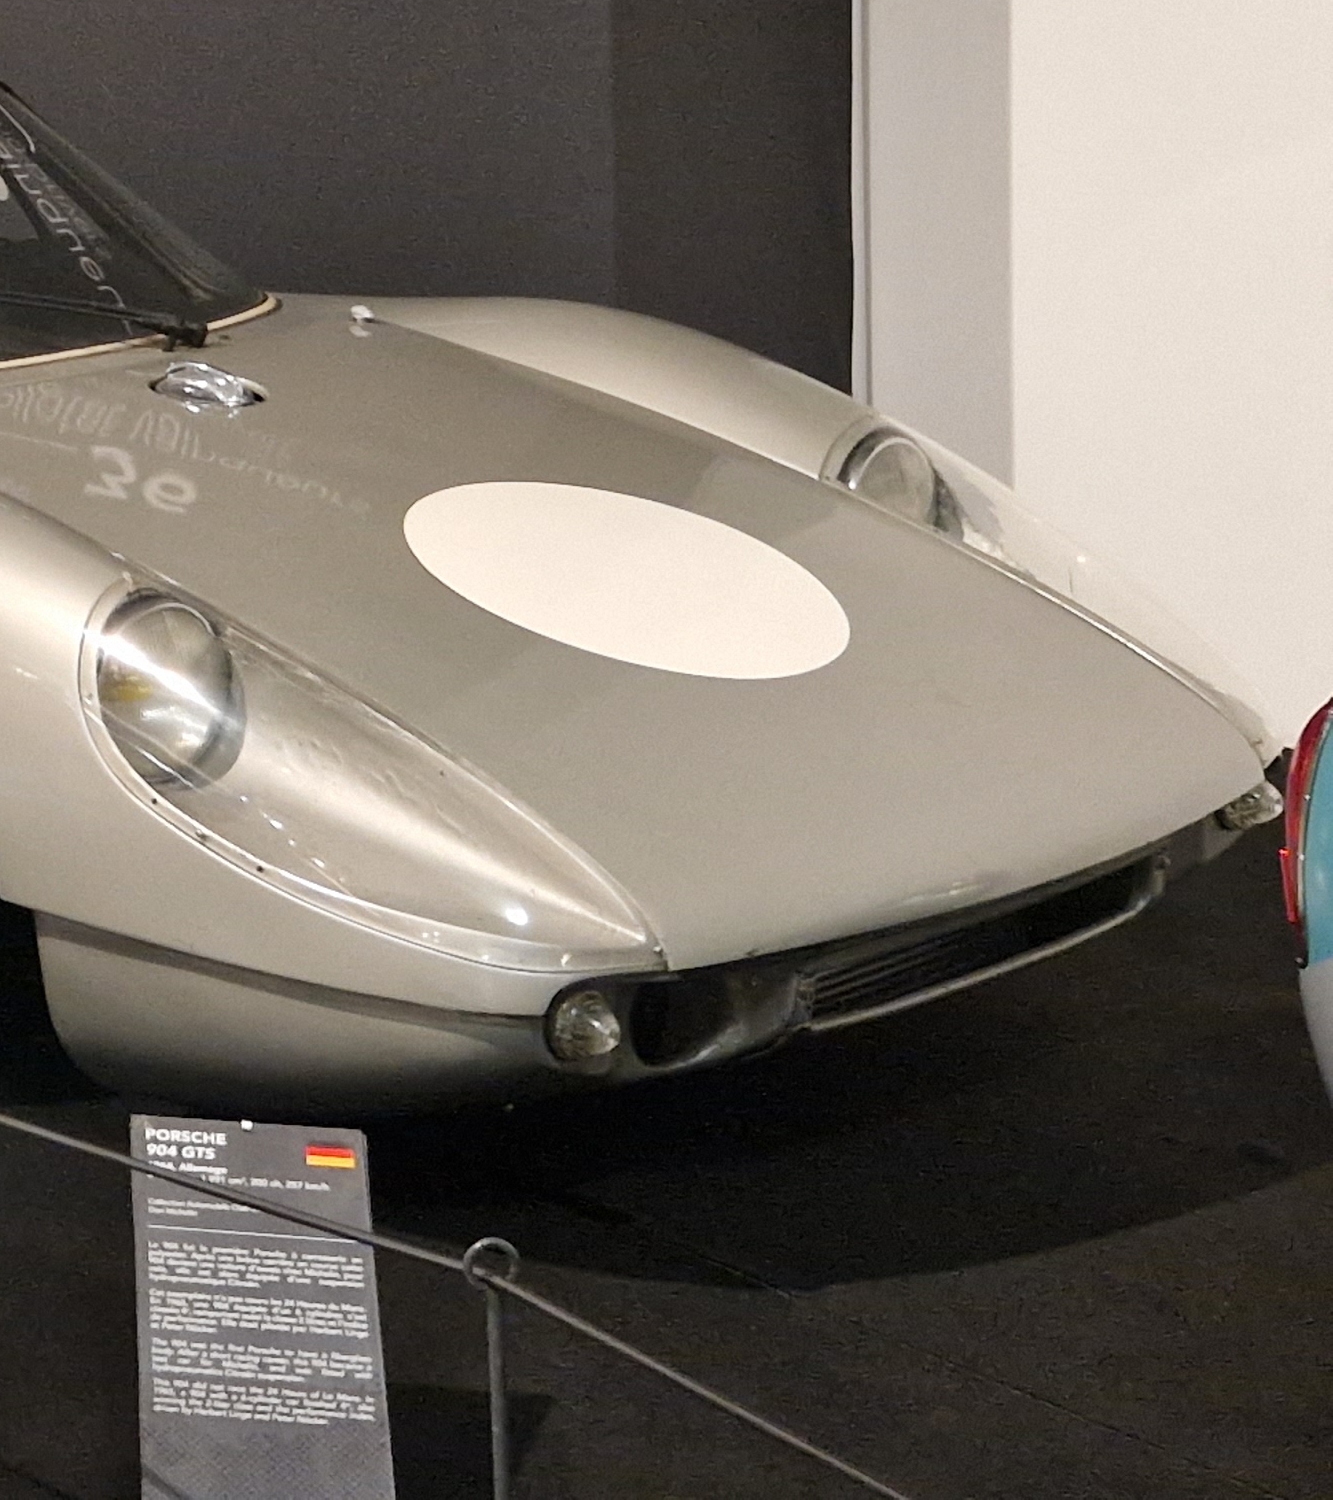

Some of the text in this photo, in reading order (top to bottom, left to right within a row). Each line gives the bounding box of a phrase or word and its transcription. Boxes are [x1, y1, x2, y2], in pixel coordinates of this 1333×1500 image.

[145, 1127, 228, 1146] PORSCHE
[146, 1143, 216, 1160] 904 GTS
